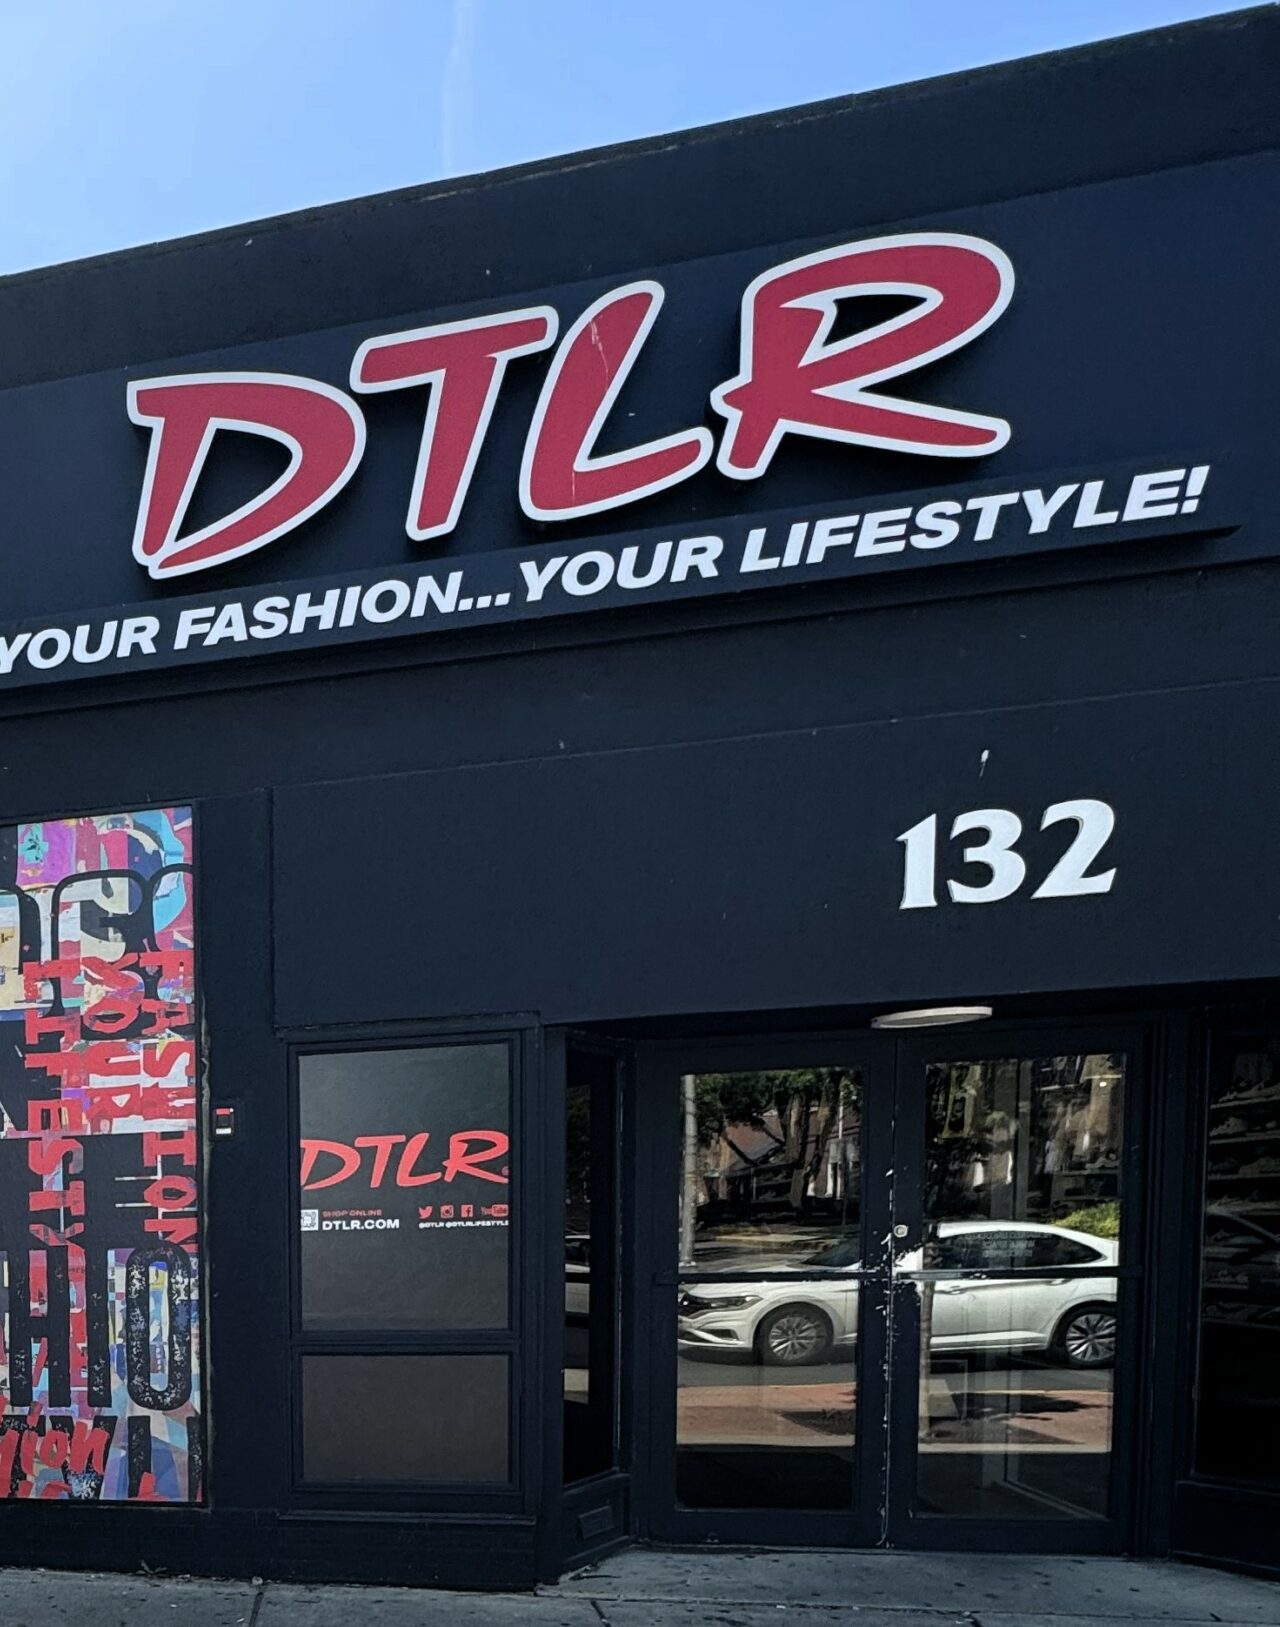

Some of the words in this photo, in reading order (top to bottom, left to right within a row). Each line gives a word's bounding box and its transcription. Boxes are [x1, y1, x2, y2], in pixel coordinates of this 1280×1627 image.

[126, 231, 1016, 580] DTLR
[738, 464, 1211, 573] LIFESTYLE!
[895, 799, 1117, 909] 132
[300, 1130, 509, 1190] DTLR
[322, 1210, 348, 1218] SHOP
[322, 1218, 400, 1231] DTLR.COM
